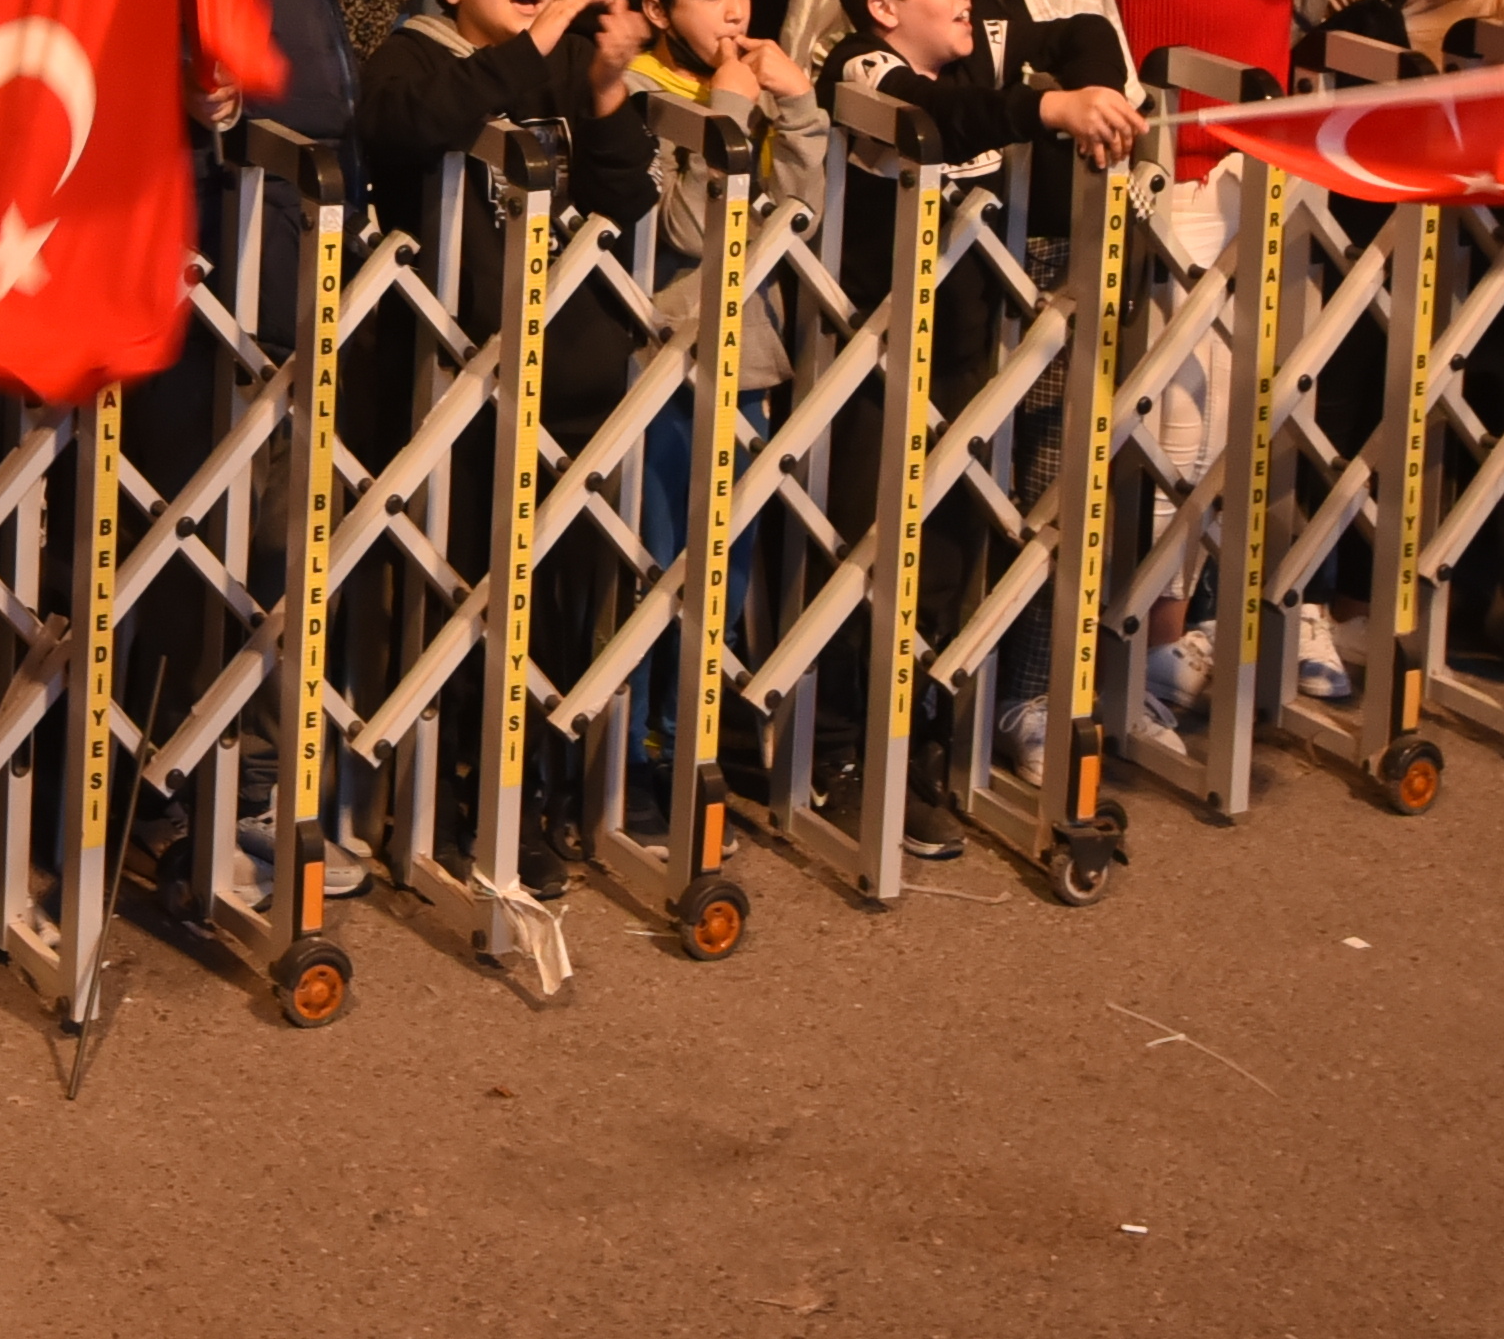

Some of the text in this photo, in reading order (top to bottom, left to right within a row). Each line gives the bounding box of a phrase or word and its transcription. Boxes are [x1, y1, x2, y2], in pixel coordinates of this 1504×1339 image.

[305, 244, 336, 789] TORBALI BELEDİYESİ
[510, 228, 544, 762] TORBALI BELEDİYESİ
[706, 212, 744, 735] TORBALI BELEDİYESİ
[898, 200, 936, 712] TORBALI BELEDİYESİ
[1082, 187, 1122, 689] TORBALI BELEDİYESİ
[1247, 170, 1282, 641] ORBALI BELEDİYESİ
[1402, 207, 1437, 611] BALI BELEDİYESİ
[91, 519, 111, 820] BELEDİYESİ
